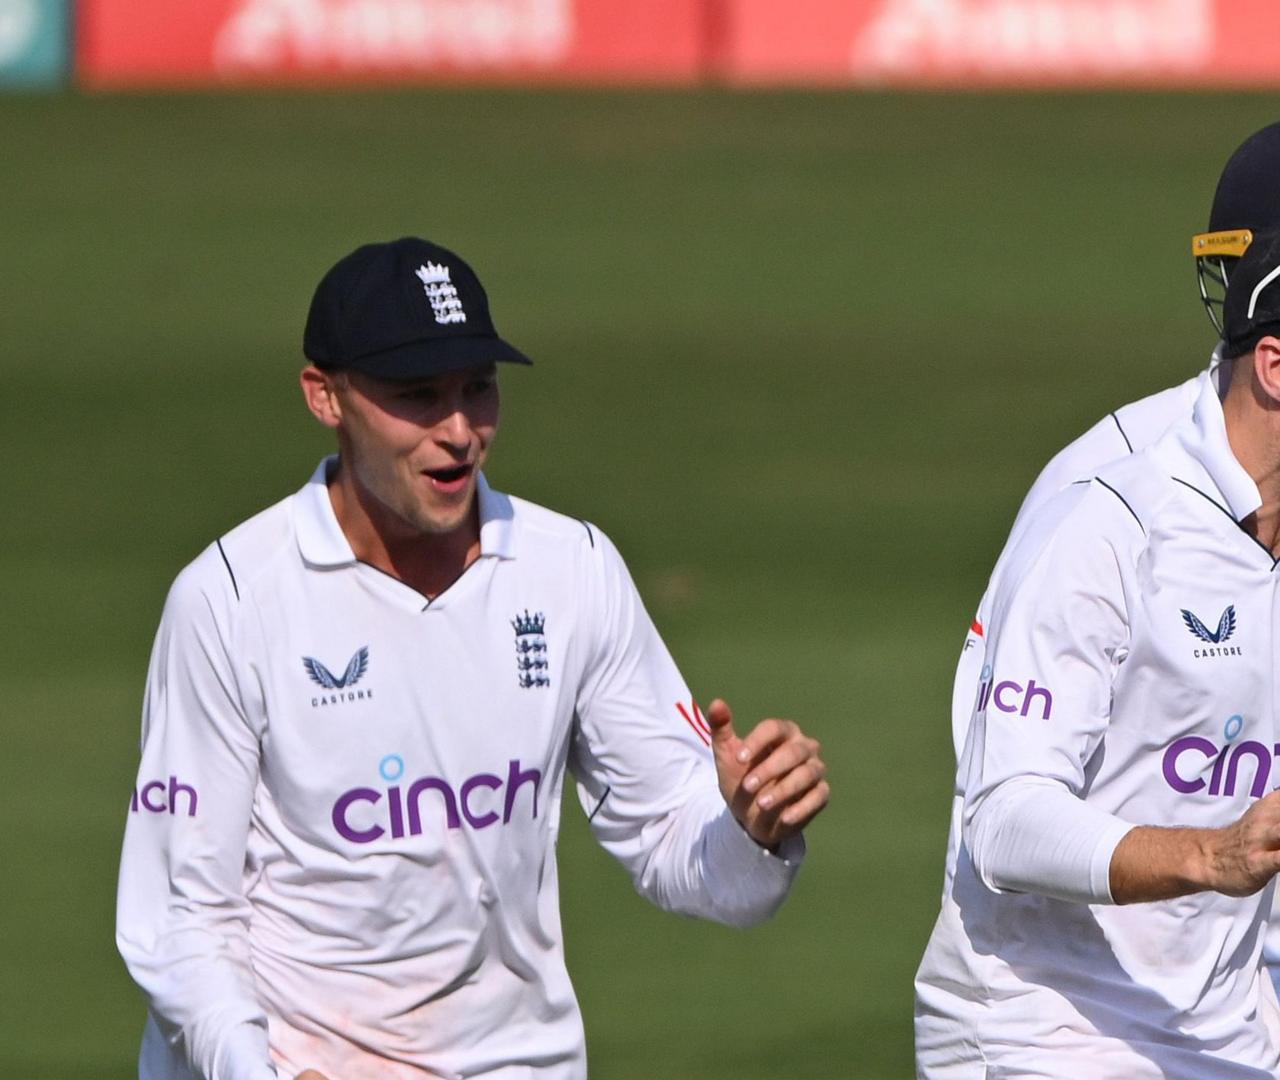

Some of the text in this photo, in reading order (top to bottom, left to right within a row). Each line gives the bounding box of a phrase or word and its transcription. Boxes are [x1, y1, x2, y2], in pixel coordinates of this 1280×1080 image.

[1193, 646, 1242, 658] CASTORE
[311, 689, 373, 707] CASTORE
[332, 753, 541, 844] cinch
